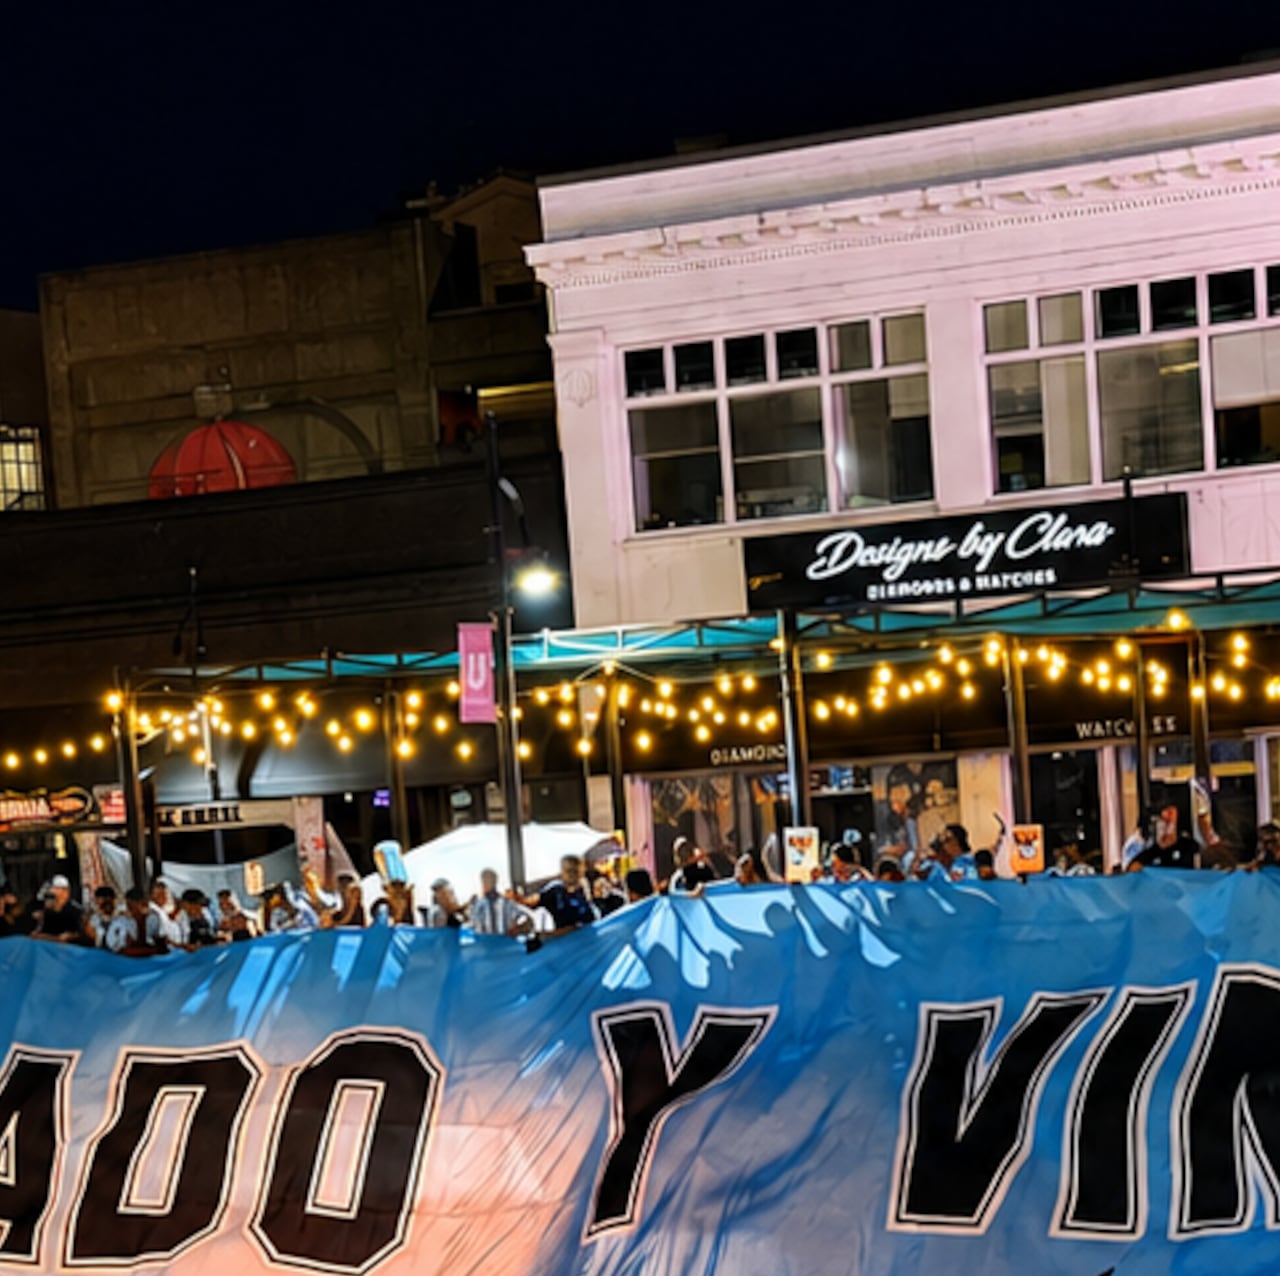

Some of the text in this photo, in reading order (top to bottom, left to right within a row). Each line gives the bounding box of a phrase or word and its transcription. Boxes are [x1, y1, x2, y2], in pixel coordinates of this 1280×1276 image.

[957, 522, 1007, 574] by
[468, 653, 486, 691] U
[579, 1001, 779, 1243] Y
